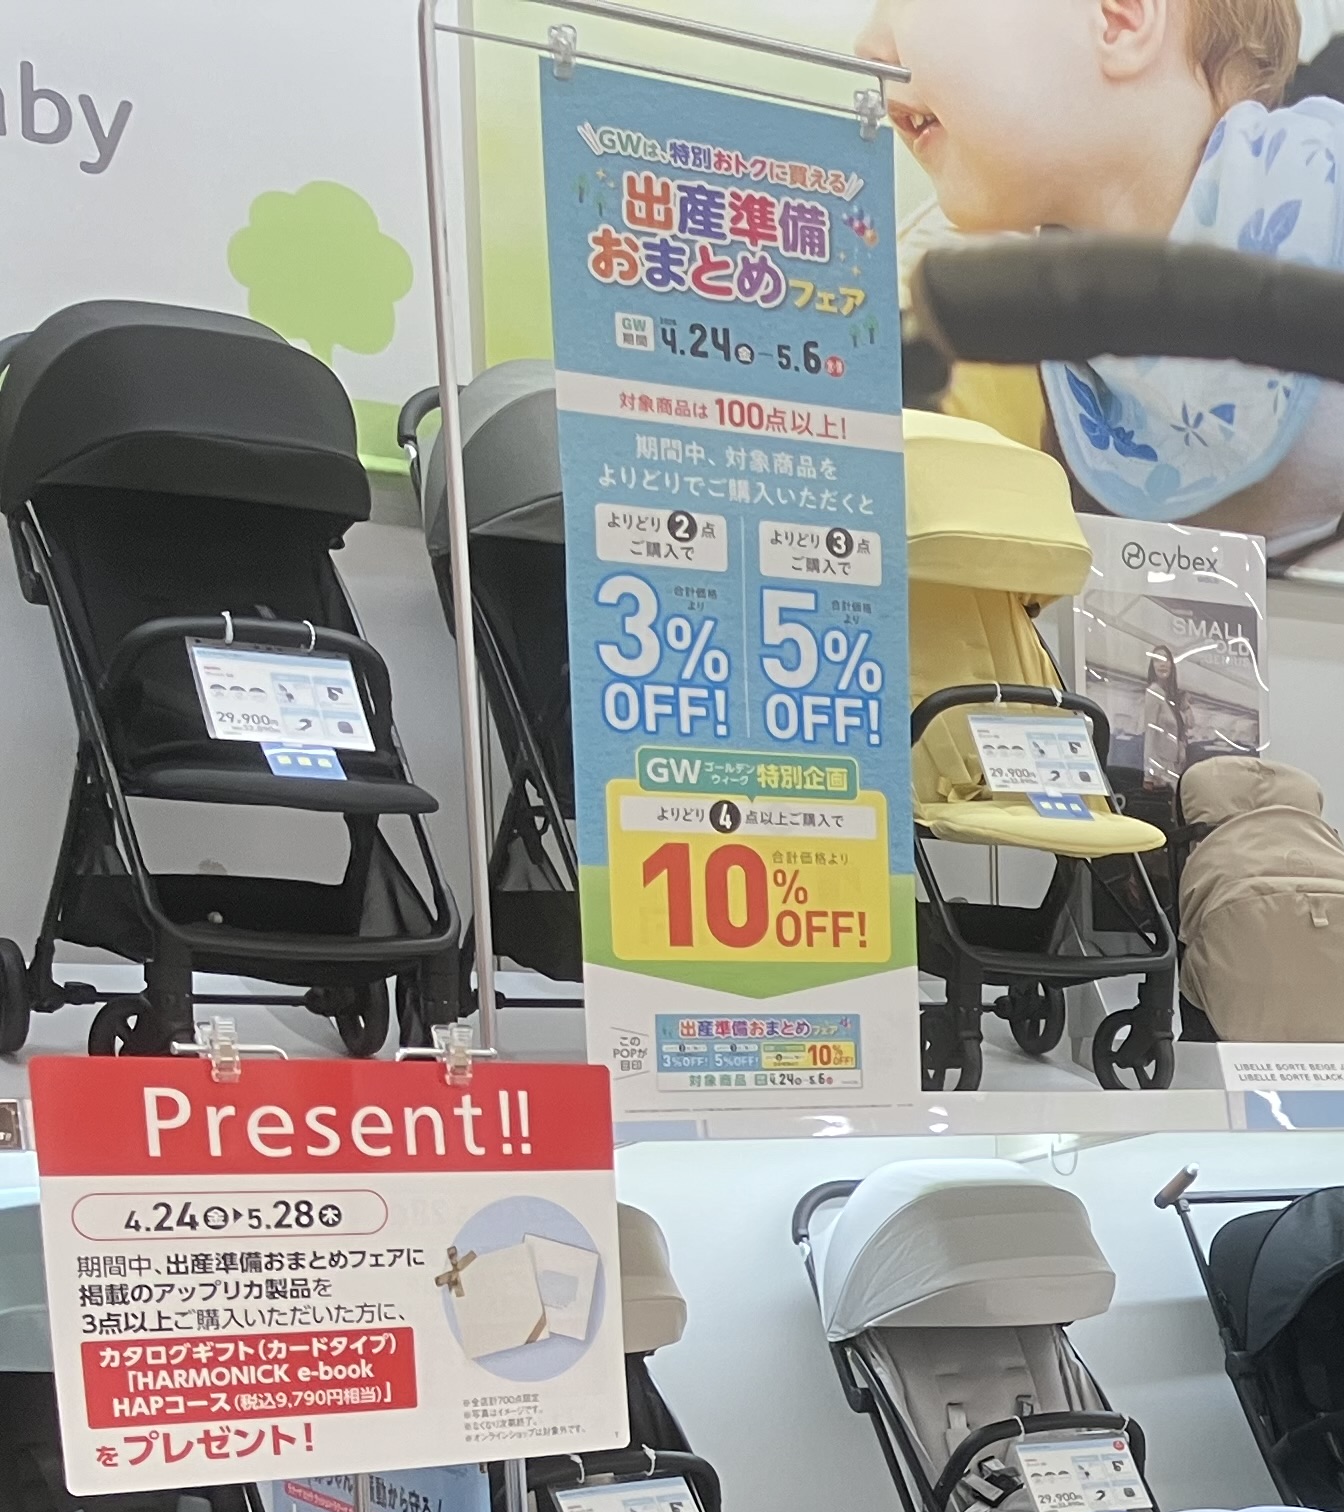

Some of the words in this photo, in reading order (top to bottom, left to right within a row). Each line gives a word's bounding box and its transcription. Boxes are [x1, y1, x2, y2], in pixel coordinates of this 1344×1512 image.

[0, 61, 133, 174] by
[599, 129, 847, 194] GWは、特別おトクに買える
[626, 174, 827, 258] 出産準備
[591, 228, 867, 317] おまとめフェア
[622, 318, 647, 333] GW
[661, 323, 731, 359] 4.24
[777, 340, 822, 374] 5.6
[635, 434, 838, 482] 期間中、対象商品を
[597, 464, 875, 516] よりどりでご購入いただくと
[607, 508, 716, 543] よりどり2点
[769, 525, 872, 558] よりどり3点
[629, 540, 696, 561] ご購入で
[790, 556, 853, 577] ご購入で
[1149, 544, 1219, 573] cybex
[598, 575, 729, 683] 3%
[761, 588, 883, 693] 5%
[604, 683, 729, 736] OFF!
[765, 693, 882, 746] OFF!
[647, 757, 702, 786] GW
[757, 764, 849, 793] 特別企画
[656, 800, 845, 833] よりどり4点以上ご購入で
[776, 910, 868, 949] OFF!
[143, 1085, 532, 1158] Present!!
[124, 1200, 200, 1232] 4.24
[247, 1199, 314, 1230] 5.28
[77, 1247, 425, 1279] 期間中、出産準備おまとめフェアに
[79, 1277, 333, 1307] 掲載のアップリカ製品を
[81, 1304, 406, 1336] 3点以上ご購入いただいた方に、
[297, 1358, 375, 1383] e-book
[95, 1423, 315, 1467] をプレゼント!
